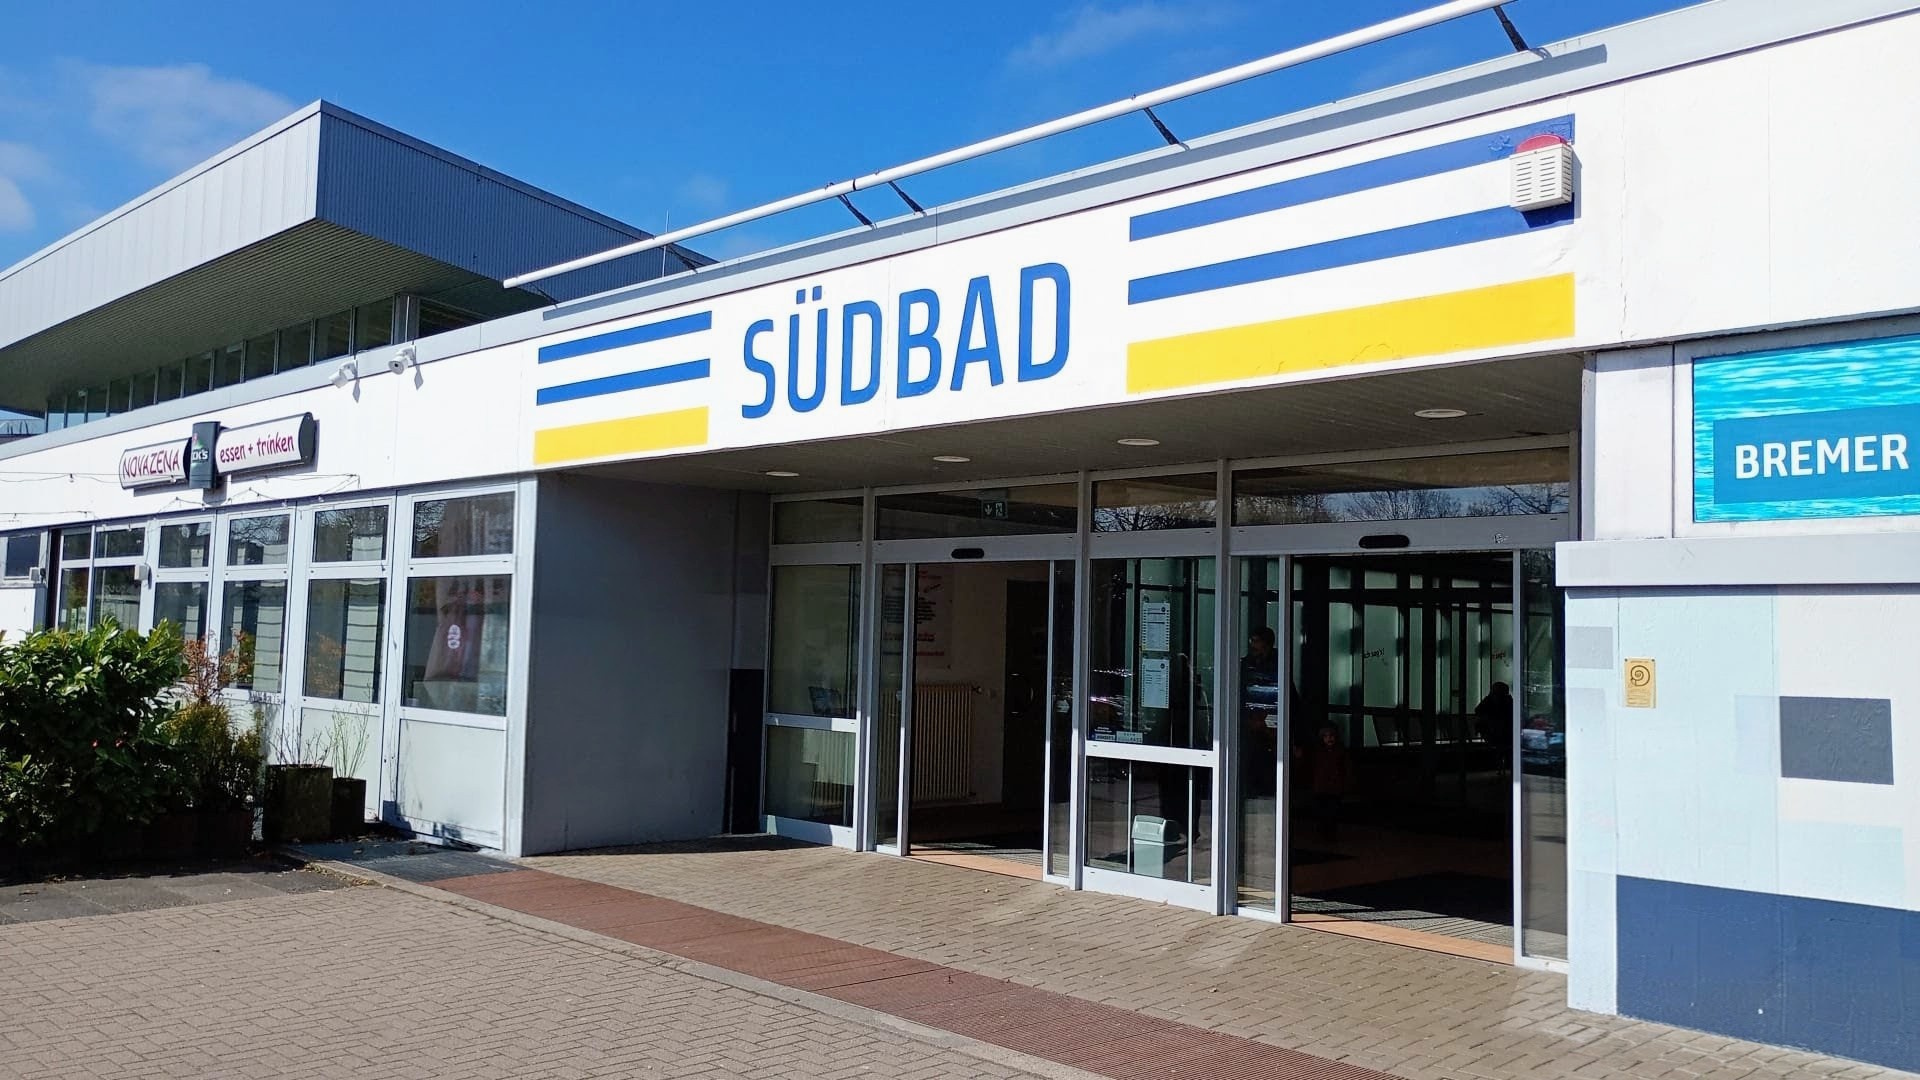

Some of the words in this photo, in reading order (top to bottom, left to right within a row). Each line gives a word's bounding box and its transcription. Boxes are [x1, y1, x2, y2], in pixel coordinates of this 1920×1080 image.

[742, 262, 1071, 419] SÜDBAD
[121, 448, 181, 479] NOVAZENA
[220, 443, 246, 463] essen
[256, 433, 295, 458] trinken
[1735, 433, 1910, 479] BREMER
